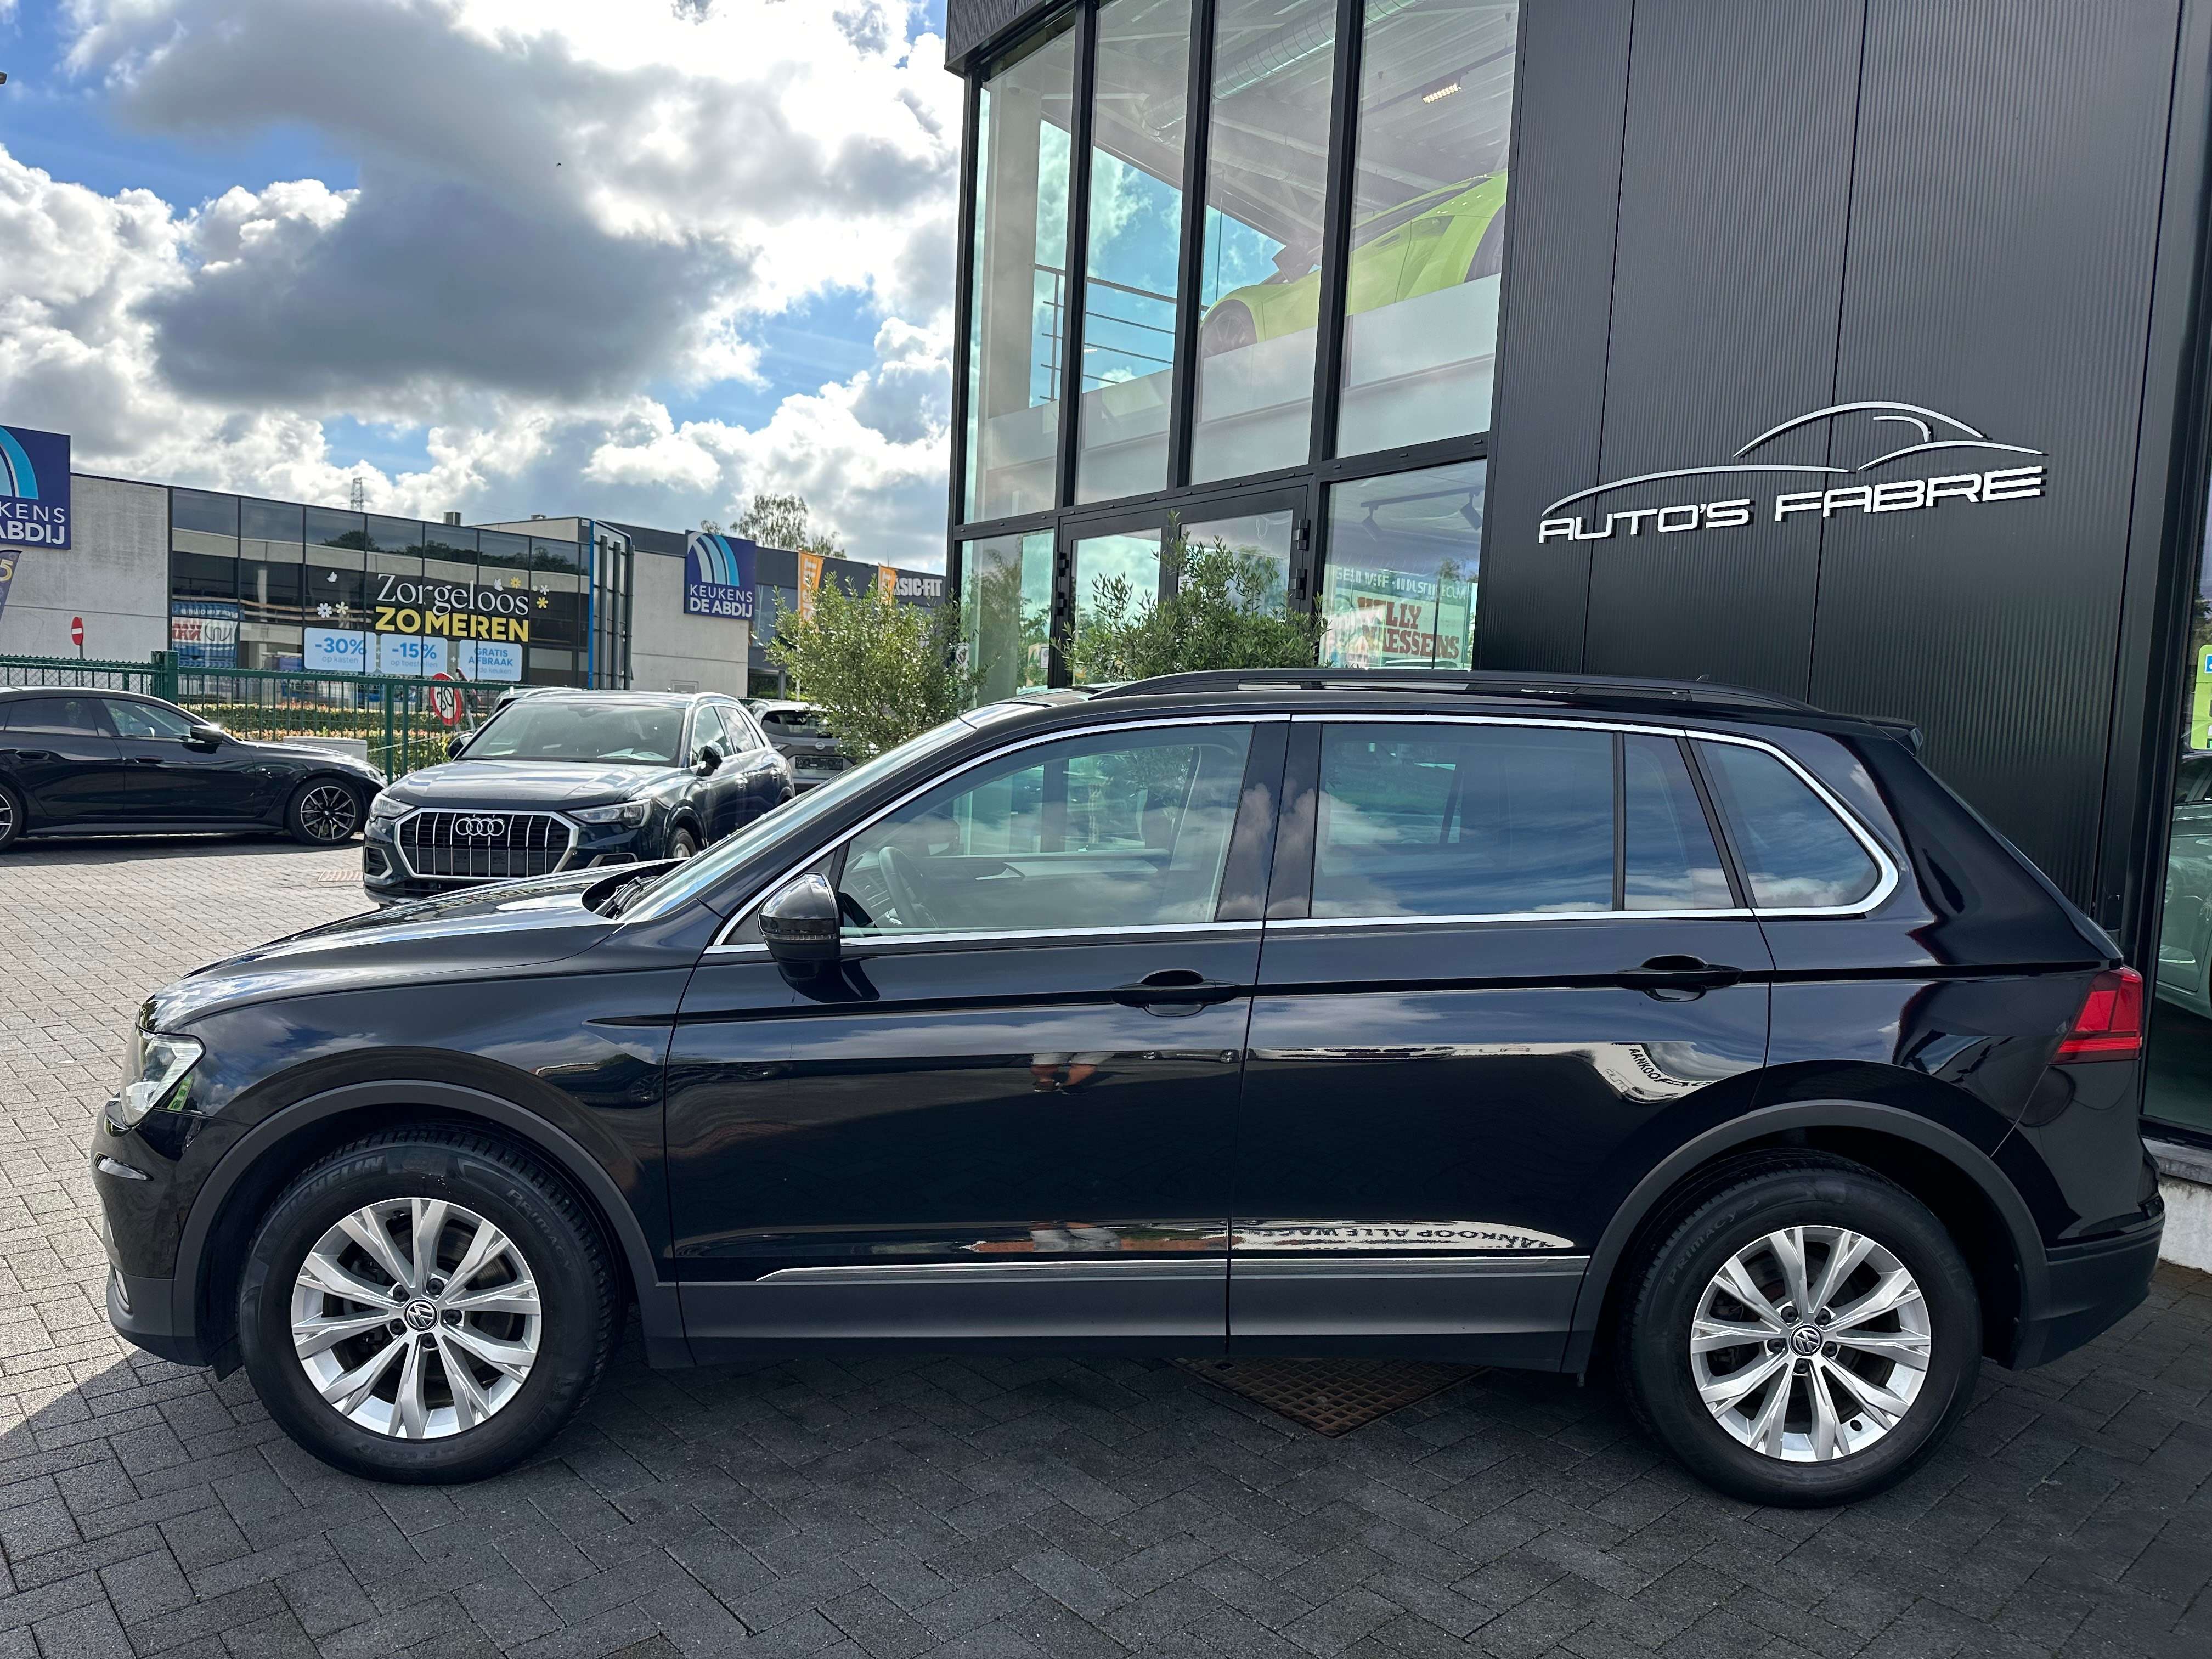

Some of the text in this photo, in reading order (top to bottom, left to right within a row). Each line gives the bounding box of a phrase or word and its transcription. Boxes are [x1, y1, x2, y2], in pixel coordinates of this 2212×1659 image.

[1538, 466, 2043, 543] AUTO'S FABRE
[377, 574, 529, 616] Zorgeloos
[690, 584, 753, 603] KEUKENS
[894, 577, 943, 597] ASIC-FIT
[690, 597, 753, 618] DE ABDIJ
[1357, 596, 1422, 630] LLY
[375, 606, 529, 642] ZOMEREN
[315, 637, 367, 655] -30%
[392, 642, 437, 659] -15%
[474, 647, 508, 657] GRATIS
[469, 656, 513, 667] AFBRAAK
